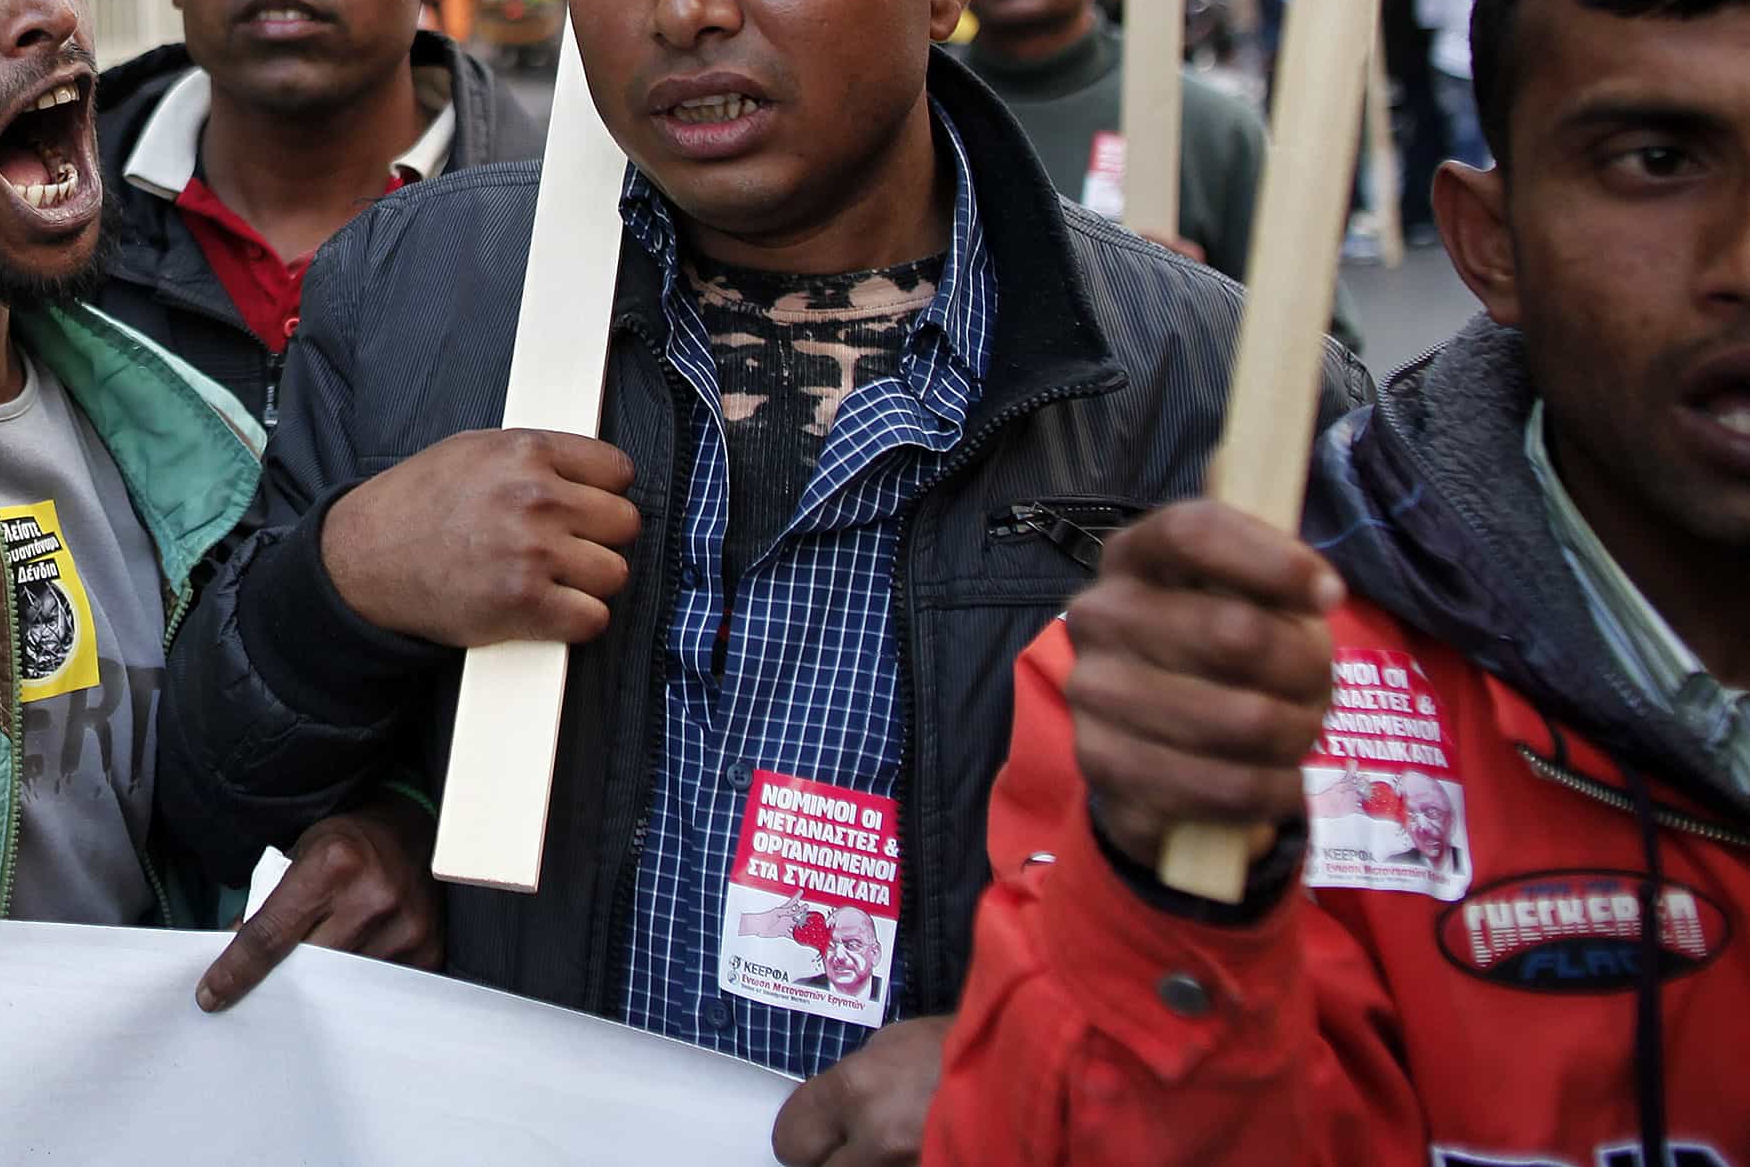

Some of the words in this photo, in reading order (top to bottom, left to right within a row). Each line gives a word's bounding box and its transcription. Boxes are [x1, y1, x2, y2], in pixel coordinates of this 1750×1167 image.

[17, 561, 58, 584] Δένδια
[1416, 694, 1437, 715] &
[761, 783, 858, 825] ΝΟΜΙΜΟΙ
[861, 808, 883, 831] ΟΙ
[753, 831, 897, 882] ΟΡΓΑΝΩΜΕΝΟΙ
[757, 807, 880, 854] ΜΕΤΑΝΑΣΤΕΣ
[883, 837, 900, 858] &
[747, 857, 779, 881] ΣΤΑ
[783, 862, 890, 906] ΣΥΝΔΙΚΑΤΑ
[744, 961, 790, 983] ΚΕΕΡΦΑ
